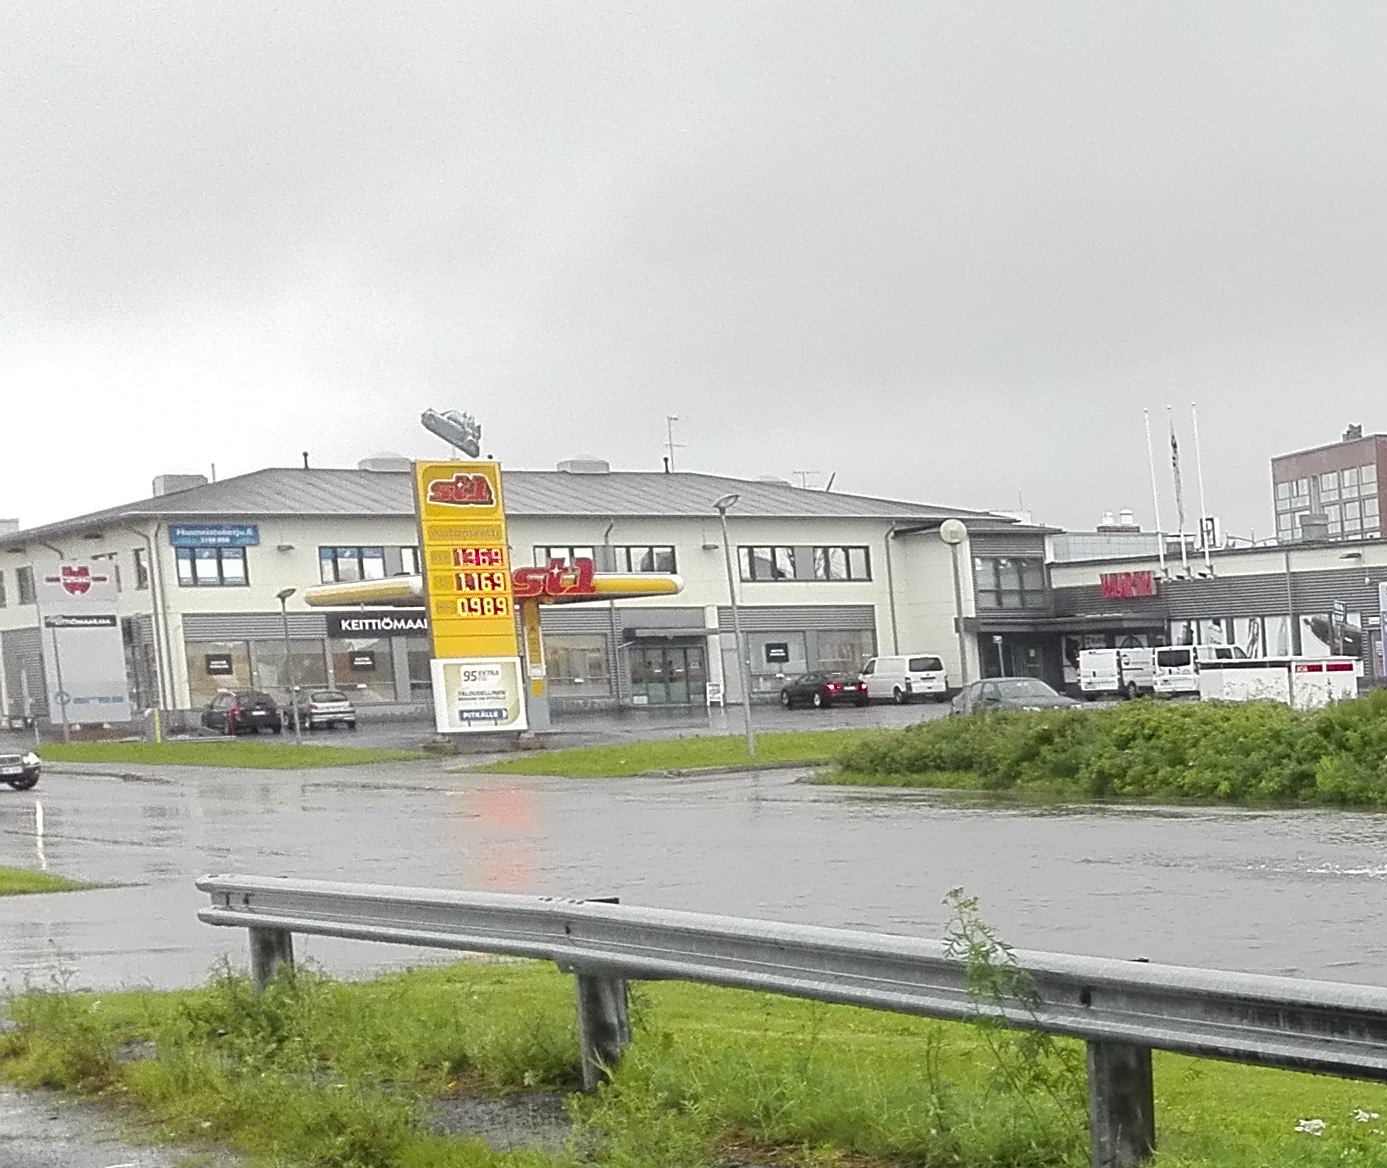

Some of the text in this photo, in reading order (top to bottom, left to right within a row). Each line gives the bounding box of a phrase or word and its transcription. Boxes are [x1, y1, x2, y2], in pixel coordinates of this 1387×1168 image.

[459, 573, 505, 591] 1.169
[341, 617, 428, 630] KEITTIÖMAAI
[463, 670, 478, 682] 95
